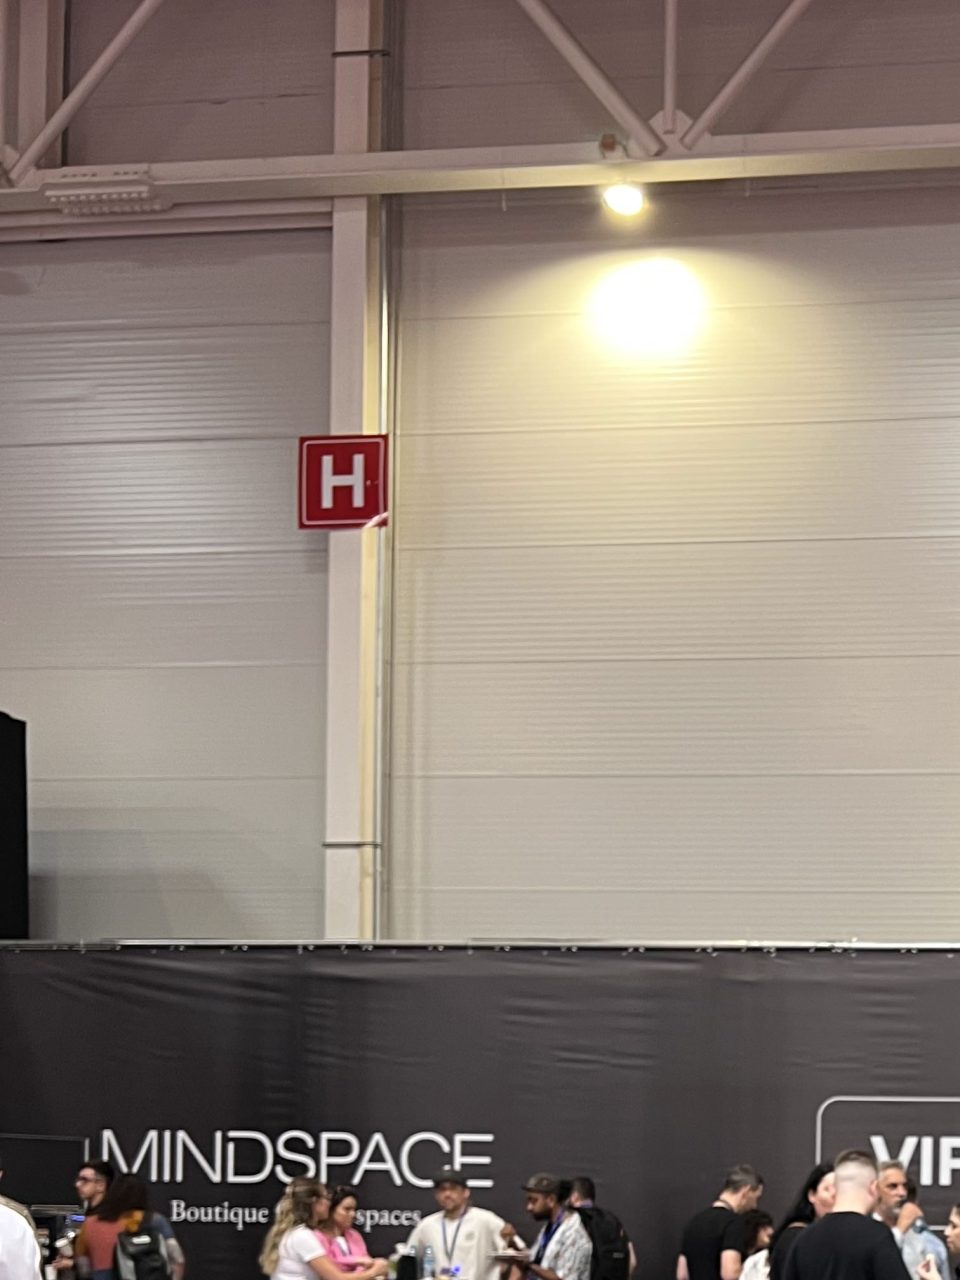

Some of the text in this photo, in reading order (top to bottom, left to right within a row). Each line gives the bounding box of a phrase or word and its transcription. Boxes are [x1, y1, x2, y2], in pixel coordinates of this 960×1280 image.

[321, 453, 365, 509] H
[102, 1129, 494, 1188] MINDSPACE
[170, 1199, 269, 1231] Boutique
